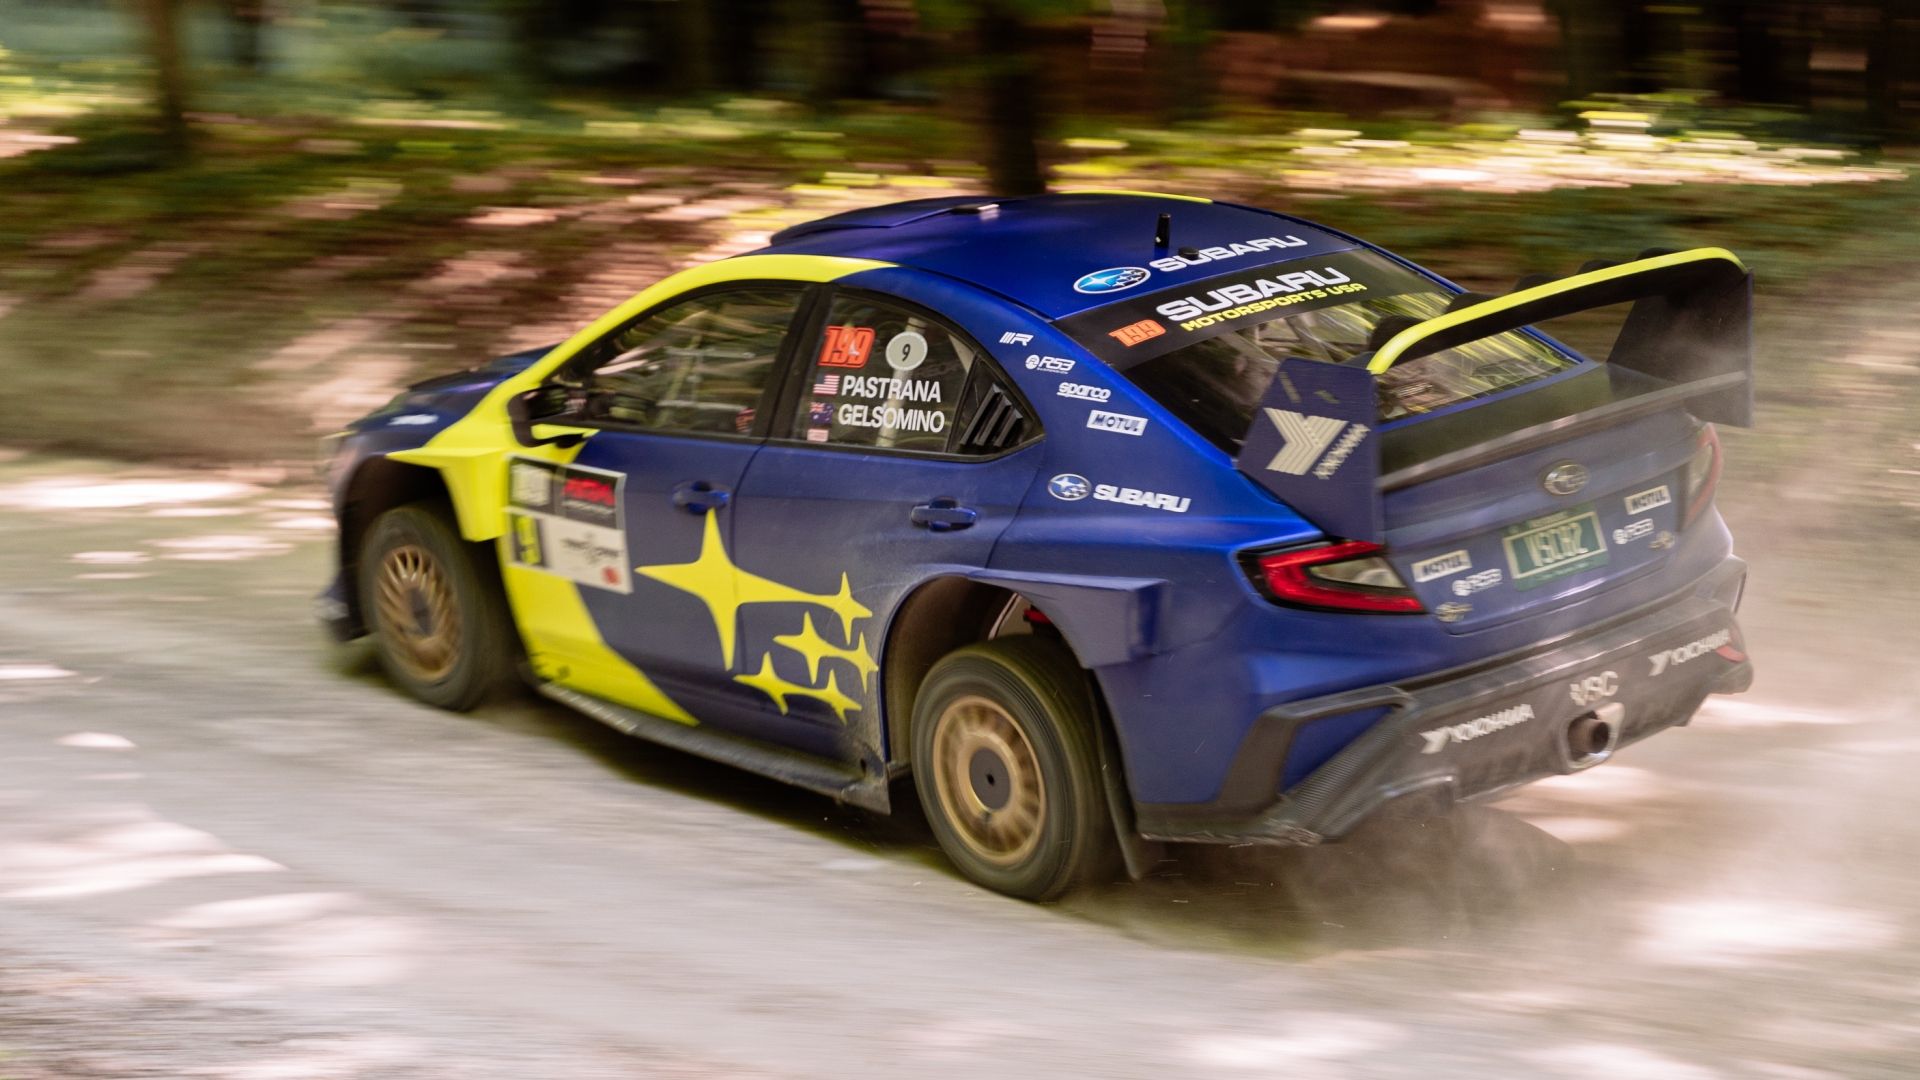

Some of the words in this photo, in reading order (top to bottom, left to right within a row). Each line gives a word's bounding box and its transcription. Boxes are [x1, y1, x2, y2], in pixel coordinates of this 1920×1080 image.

[1149, 235, 1308, 272] SUBARU
[1156, 267, 1350, 321] SUBARU
[1180, 289, 1327, 332] MOTORSPORTS
[1325, 282, 1367, 295] USA
[818, 325, 875, 368] 199
[1108, 319, 1166, 348] 199
[901, 343, 911, 361] 9
[841, 375, 942, 403] PASTRANA
[1058, 382, 1111, 402] sparco
[838, 403, 946, 433] GELSOMINO
[1092, 414, 1140, 432] MOTUL
[1093, 483, 1192, 513] SUBARU
